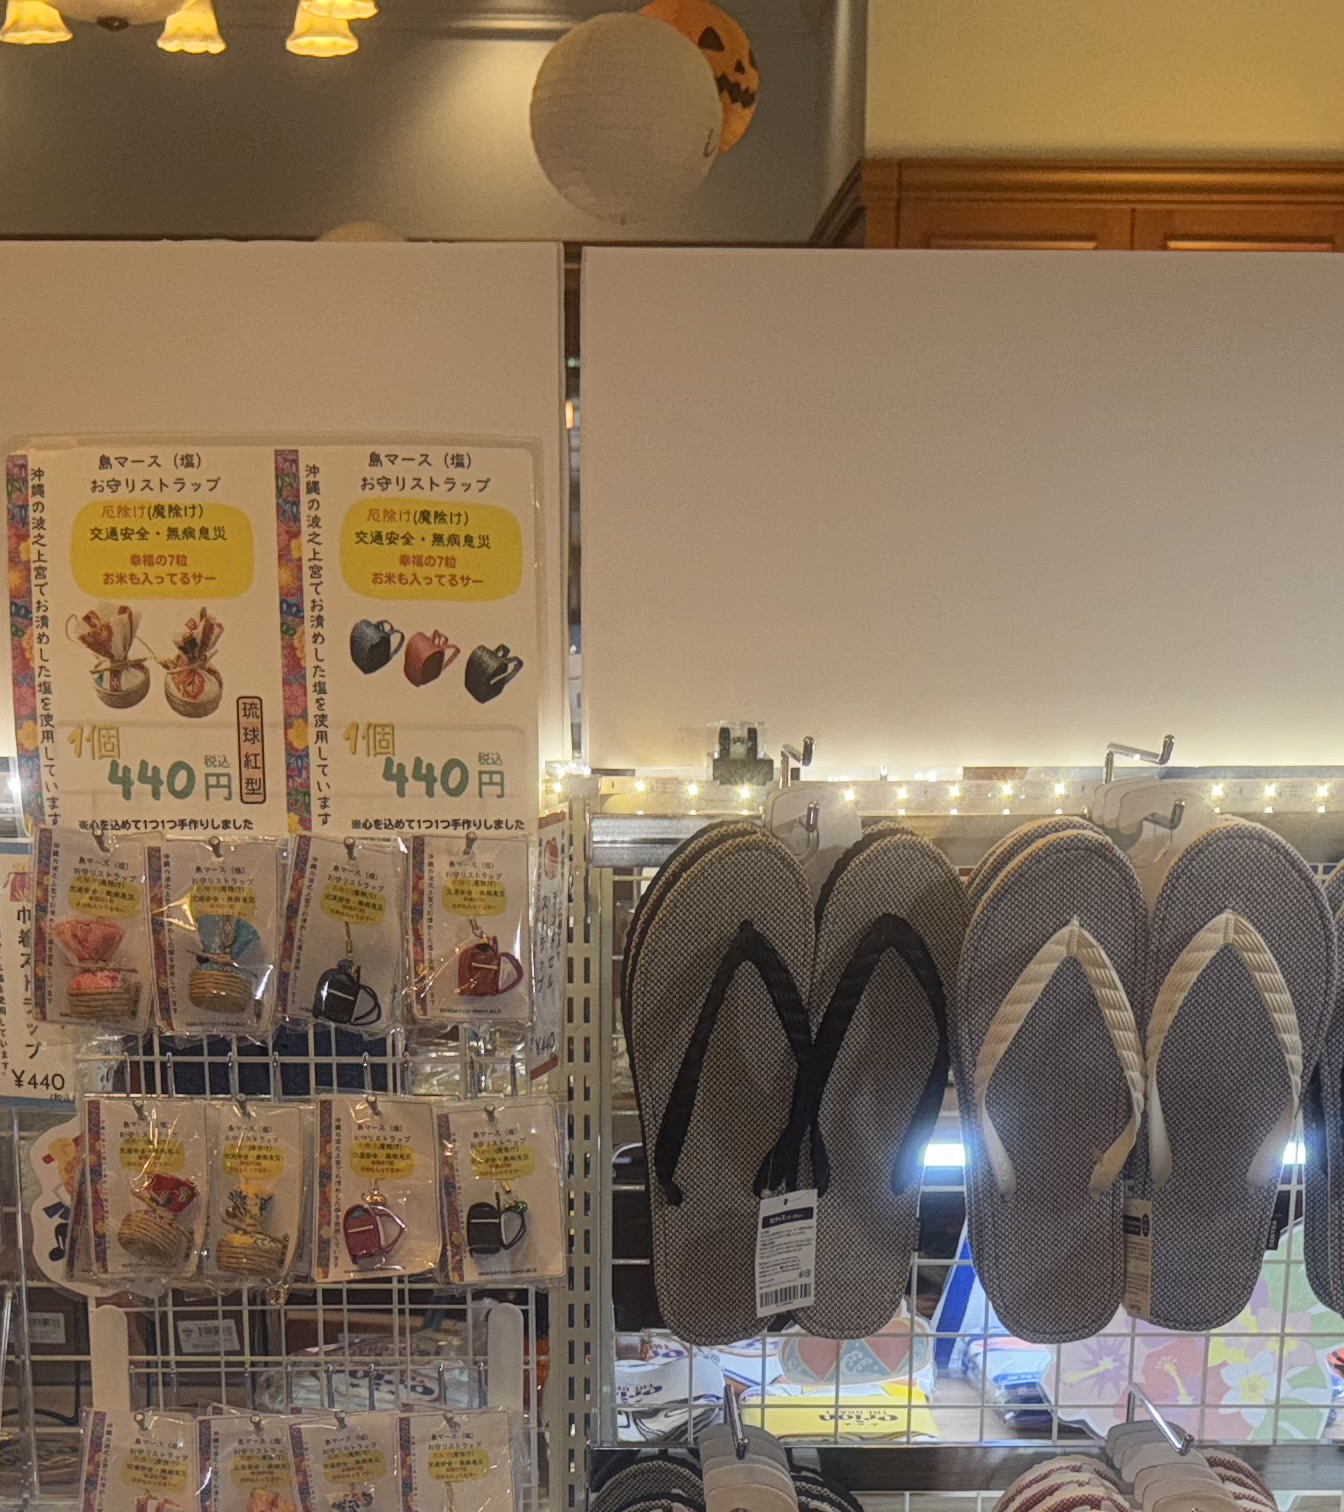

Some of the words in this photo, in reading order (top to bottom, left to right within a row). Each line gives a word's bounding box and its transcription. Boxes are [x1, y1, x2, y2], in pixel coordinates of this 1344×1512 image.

[90, 476, 221, 494] お守りストラップ
[359, 475, 491, 494] お守りストラップ
[89, 526, 228, 542] 交通安全・無病息災
[354, 530, 492, 550] 交通安全・無病息災
[129, 554, 188, 568] 幸福の7粒
[399, 554, 457, 570] 幸福の7粒
[102, 572, 217, 586] お米も入ってるサー
[371, 571, 484, 587] お米も入ってるサー
[241, 701, 263, 796] 琉球紅型
[204, 754, 230, 769] 税込
[477, 752, 502, 767] 税込
